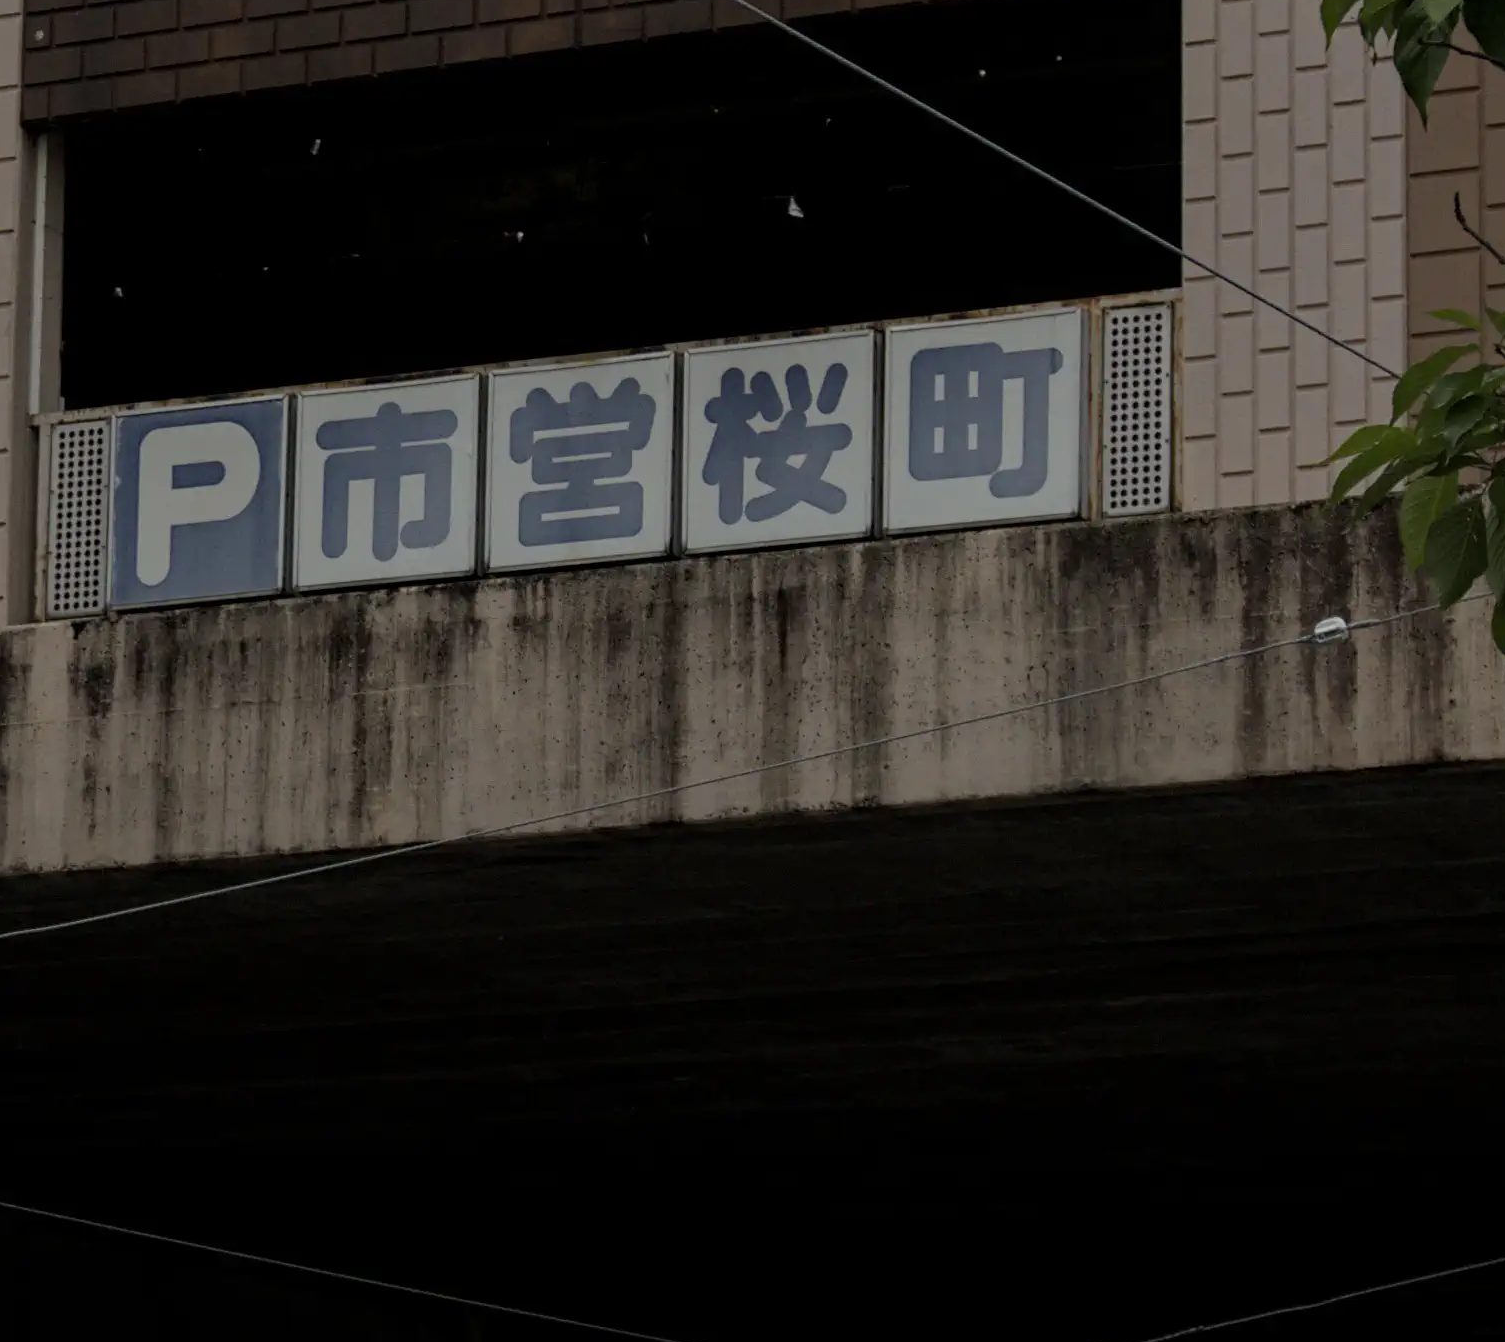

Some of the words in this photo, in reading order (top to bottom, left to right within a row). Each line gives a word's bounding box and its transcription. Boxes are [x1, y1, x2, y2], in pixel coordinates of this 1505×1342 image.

[134, 420, 262, 587] P
[314, 341, 1064, 563] 市営桜町
